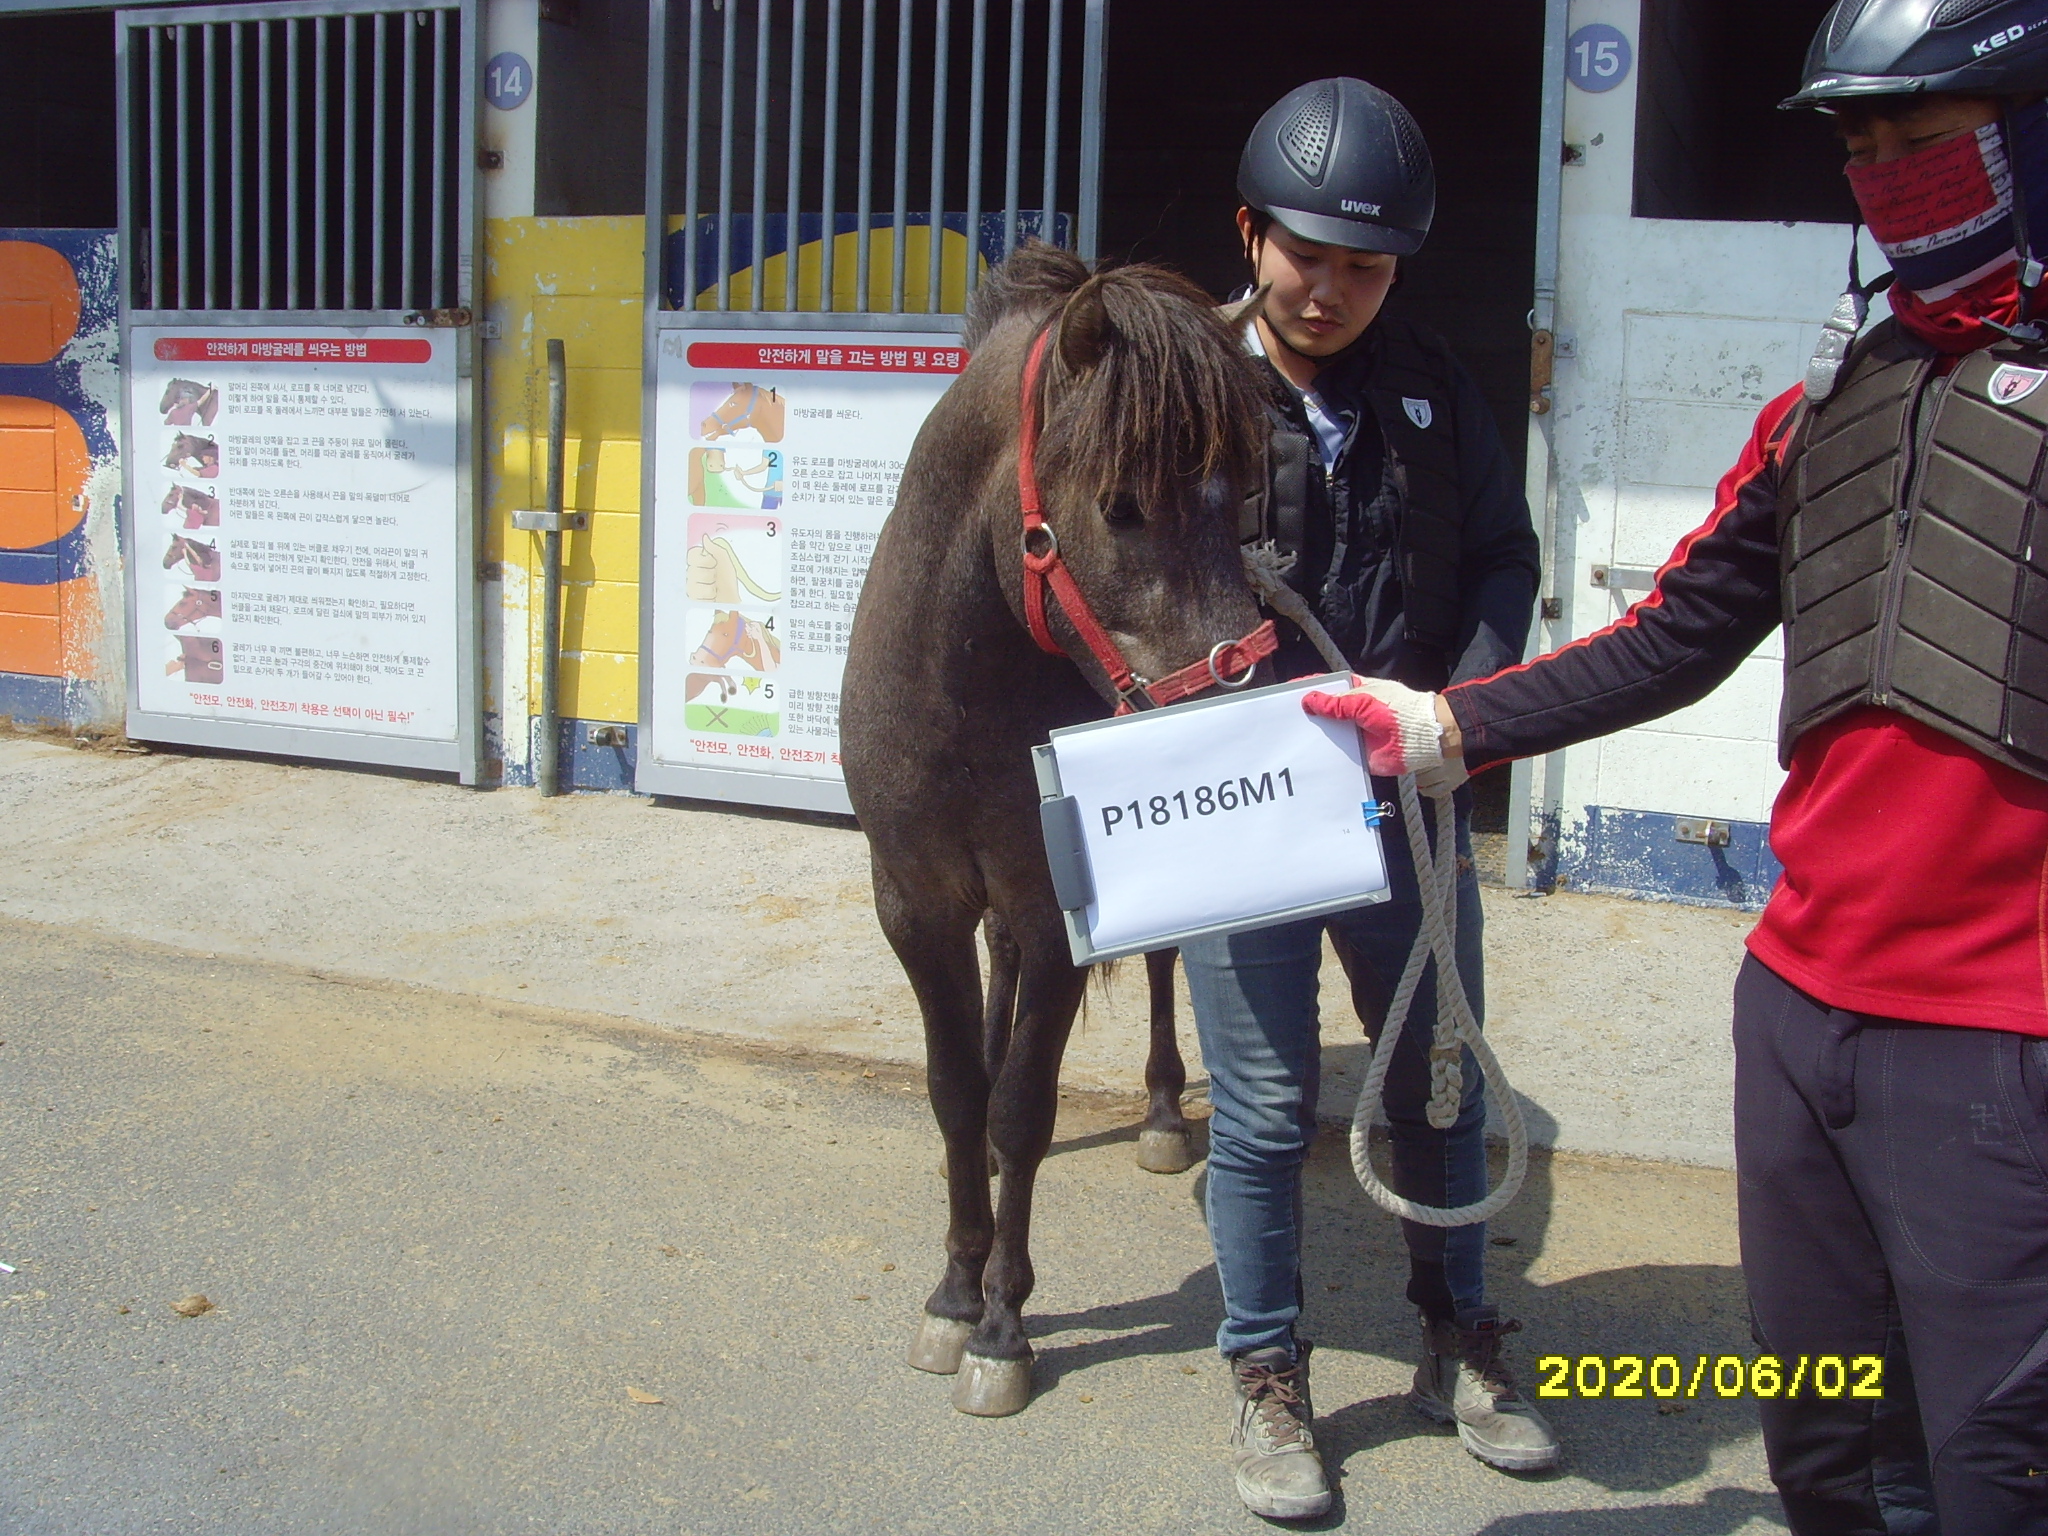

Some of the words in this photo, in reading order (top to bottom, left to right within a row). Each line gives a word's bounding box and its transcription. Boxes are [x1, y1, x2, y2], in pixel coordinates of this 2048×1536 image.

[1972, 24, 2025, 57] KED
[1574, 40, 1619, 76] 15
[491, 66, 522, 97] 14
[1340, 199, 1381, 216] uvex
[206, 341, 248, 356] 안전하게
[250, 342, 305, 356] 마방굴레를
[307, 342, 341, 357] 씌우는
[344, 343, 367, 357] 방법
[757, 348, 811, 364] 안전하게
[815, 349, 843, 365] 말을
[846, 349, 875, 366] 끄는
[879, 350, 907, 366] 방법
[912, 350, 926, 366] 및
[930, 351, 959, 367] 요령
[770, 386, 776, 403] 1
[792, 408, 833, 419] 마방굴레를
[835, 408, 863, 419] 씌운다.
[208, 434, 215, 446] 2
[228, 456, 248, 466] 위치를
[250, 457, 284, 468] 유지하도록
[285, 458, 303, 469] 한다.
[768, 452, 778, 468] 2
[791, 456, 808, 466] 유도
[810, 456, 835, 467] 로프를
[837, 457, 886, 469] 마방굴레에서
[791, 468, 808, 478] 오른
[810, 468, 834, 479] 손으로
[837, 469, 853, 480] 잡고
[856, 470, 881, 481] 나머지
[883, 471, 904, 482] 부분
[208, 486, 216, 499] 3
[791, 480, 800, 491] 이
[802, 481, 810, 491] 때
[812, 481, 830, 492] 왼손
[831, 481, 856, 492] 둘레에
[858, 482, 884, 493] 로프를
[791, 492, 815, 503] 순치가
[817, 493, 826, 504] 잘
[828, 493, 845, 504] 되어
[847, 494, 864, 505] 있는
[866, 494, 883, 506] 말은
[766, 521, 776, 538] 3
[790, 527, 822, 539] 유도자의
[824, 529, 841, 540] 몸을
[209, 538, 216, 550] 4
[790, 539, 806, 550] 손을
[808, 540, 825, 551] 약간
[827, 541, 852, 552] 앞으로
[854, 542, 872, 553] 내민
[789, 551, 830, 563] 조심스럽게
[832, 553, 849, 564] 걷기
[789, 563, 814, 574] 로프에
[816, 564, 848, 576] 가해지는
[789, 575, 808, 586] 하면,
[810, 576, 843, 588] 팔꿈치를
[845, 578, 863, 589] 굽히
[210, 590, 218, 602] 5
[789, 587, 806, 598] 돌게
[808, 588, 826, 599] 한다.
[829, 589, 854, 600] 필요할
[789, 598, 821, 611] 잡으려고
[823, 600, 840, 612] 하는
[765, 616, 775, 632] 4
[788, 618, 805, 629] 말의
[807, 619, 832, 630] 속도를
[788, 630, 805, 641] 유도
[807, 631, 831, 642] 로프를
[212, 641, 219, 653] 6
[788, 642, 805, 652] 유도
[807, 643, 831, 654] 로프가
[764, 684, 774, 699] 5
[788, 688, 804, 700] 급한
[189, 692, 223, 707] “안전모,
[226, 695, 256, 710] 안전화,
[260, 698, 297, 713] 안전조끼
[300, 702, 329, 716] 착용은
[332, 704, 361, 719] 선택이
[364, 707, 383, 721] 아닌
[386, 709, 414, 723] 필수!”
[788, 700, 804, 712] 미리
[806, 702, 822, 713] 방향
[787, 712, 804, 723] 또한
[806, 713, 830, 725] 바닥에
[787, 723, 804, 735] 있는
[805, 725, 839, 738] 사물과는
[689, 739, 732, 756] “안전모,
[736, 743, 774, 759] 안전화,
[779, 746, 825, 763] 안전조끼
[1101, 766, 1295, 836] P18186M1
